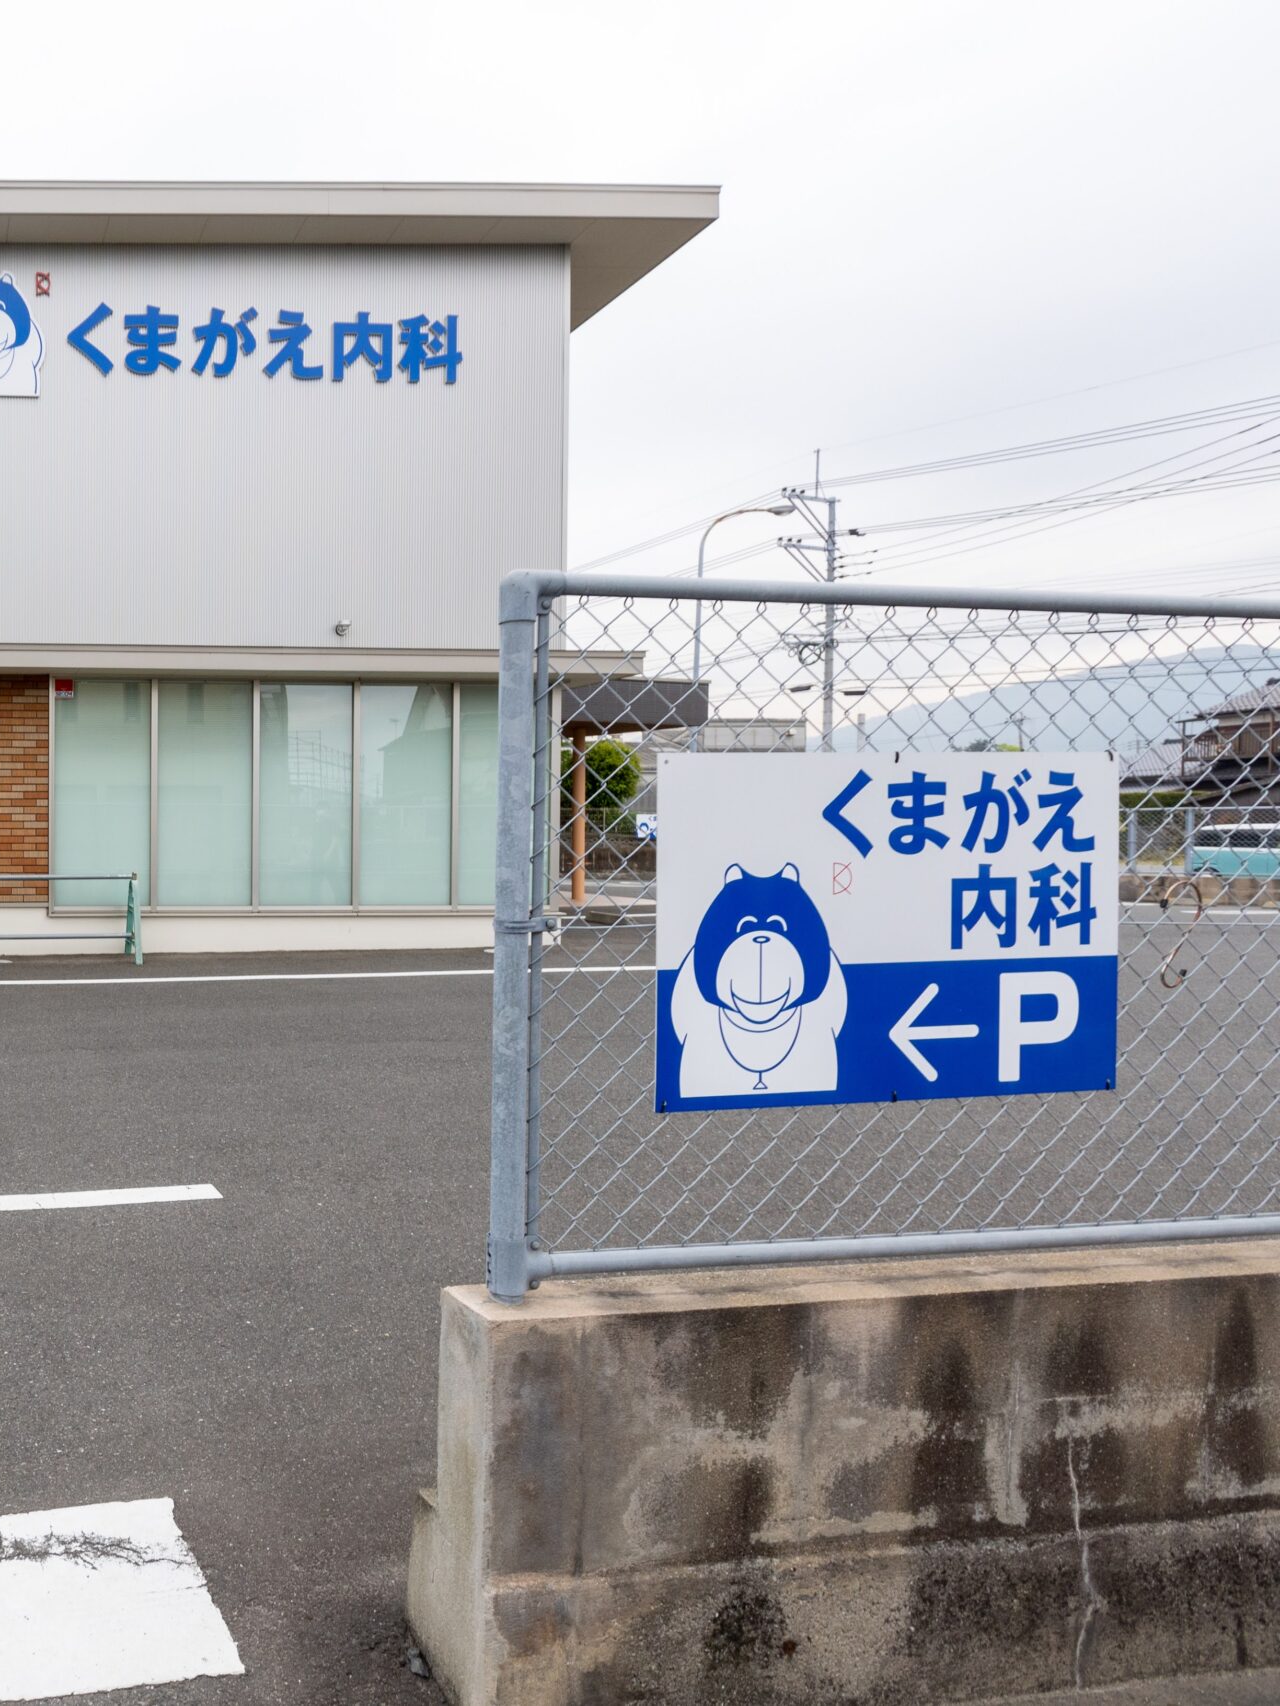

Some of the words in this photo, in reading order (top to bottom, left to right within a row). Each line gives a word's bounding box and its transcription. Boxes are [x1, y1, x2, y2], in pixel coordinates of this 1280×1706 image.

[66, 302, 464, 384] くまがえ内科
[822, 768, 1096, 859] くまがえ
[950, 861, 1097, 950] 内科
[998, 971, 1079, 1082] P
